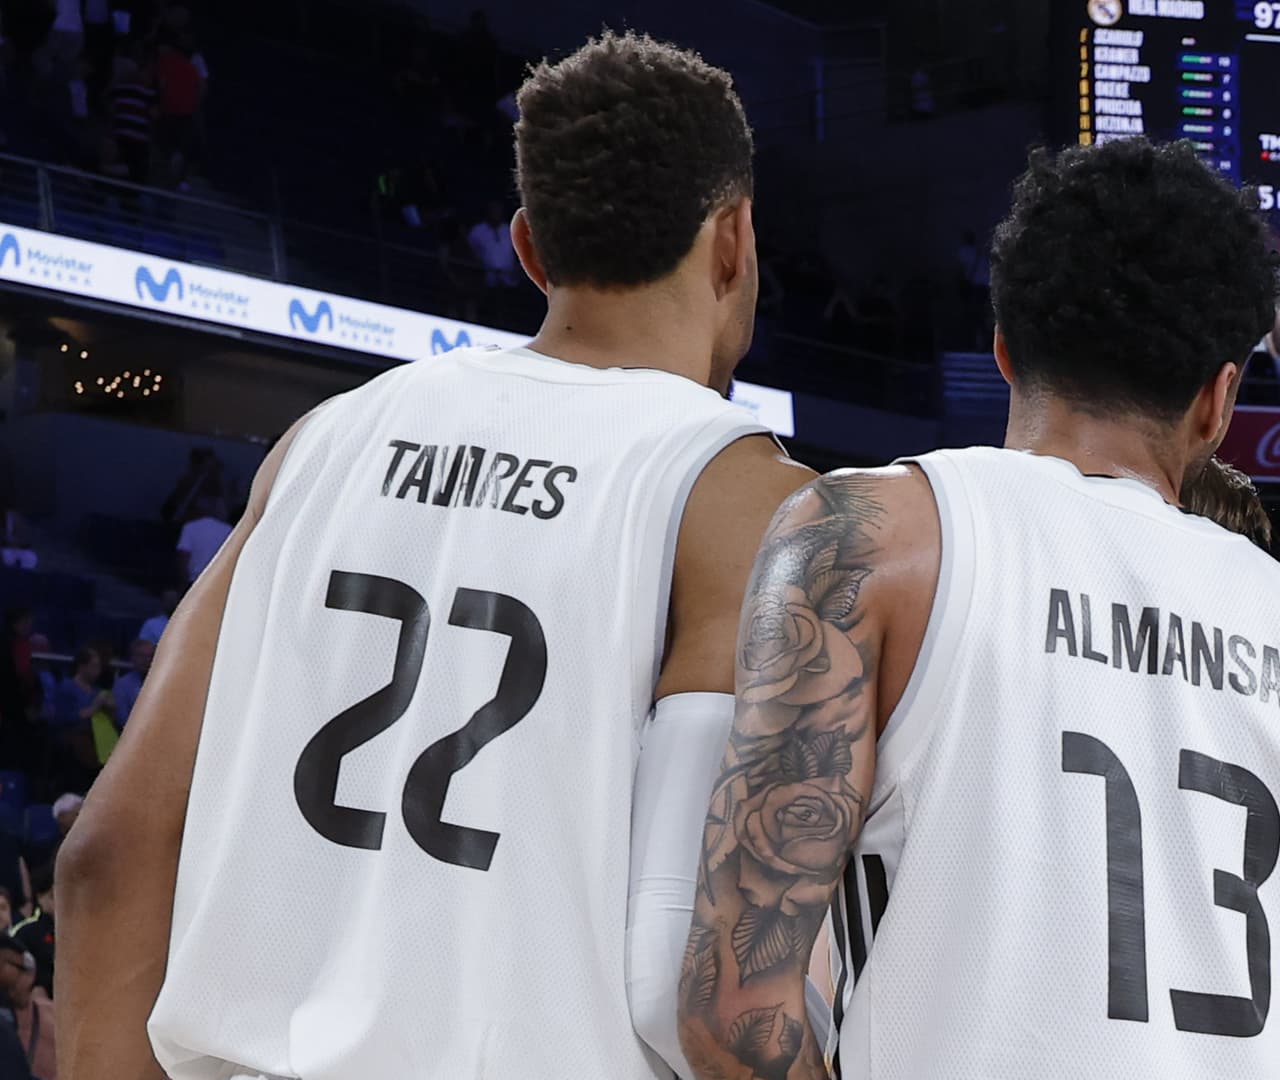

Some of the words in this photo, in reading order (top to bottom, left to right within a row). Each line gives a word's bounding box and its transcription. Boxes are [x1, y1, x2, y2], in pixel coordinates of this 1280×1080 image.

[1258, 185, 1274, 210] 5
[27, 247, 94, 273] Movistar
[188, 282, 249, 305] Movistar
[293, 569, 548, 872] 22
